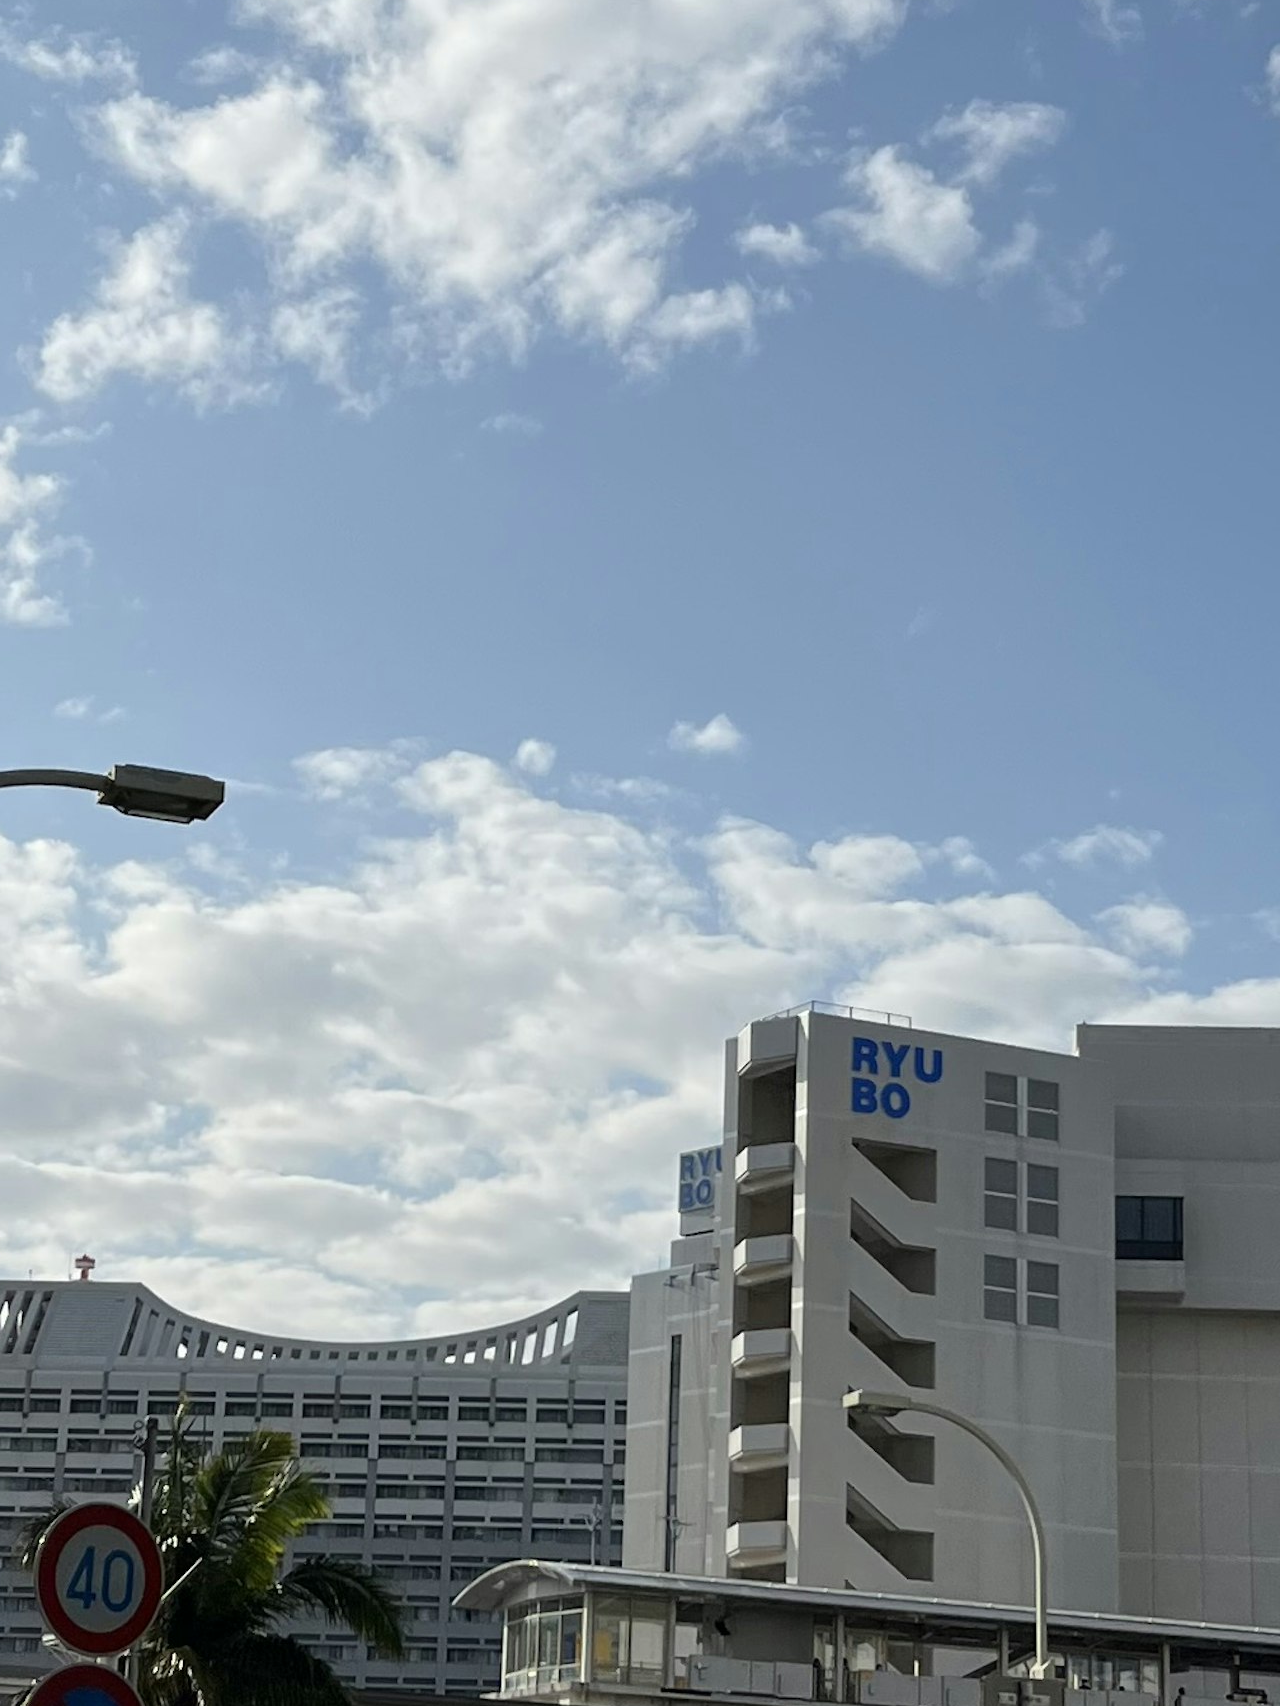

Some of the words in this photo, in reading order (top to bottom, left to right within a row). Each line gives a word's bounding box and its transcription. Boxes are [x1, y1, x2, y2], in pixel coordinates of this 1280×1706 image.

[851, 1036, 943, 1084] RYU
[851, 1077, 911, 1119] BO
[679, 1179, 712, 1210] BO
[66, 1545, 134, 1613] 40
